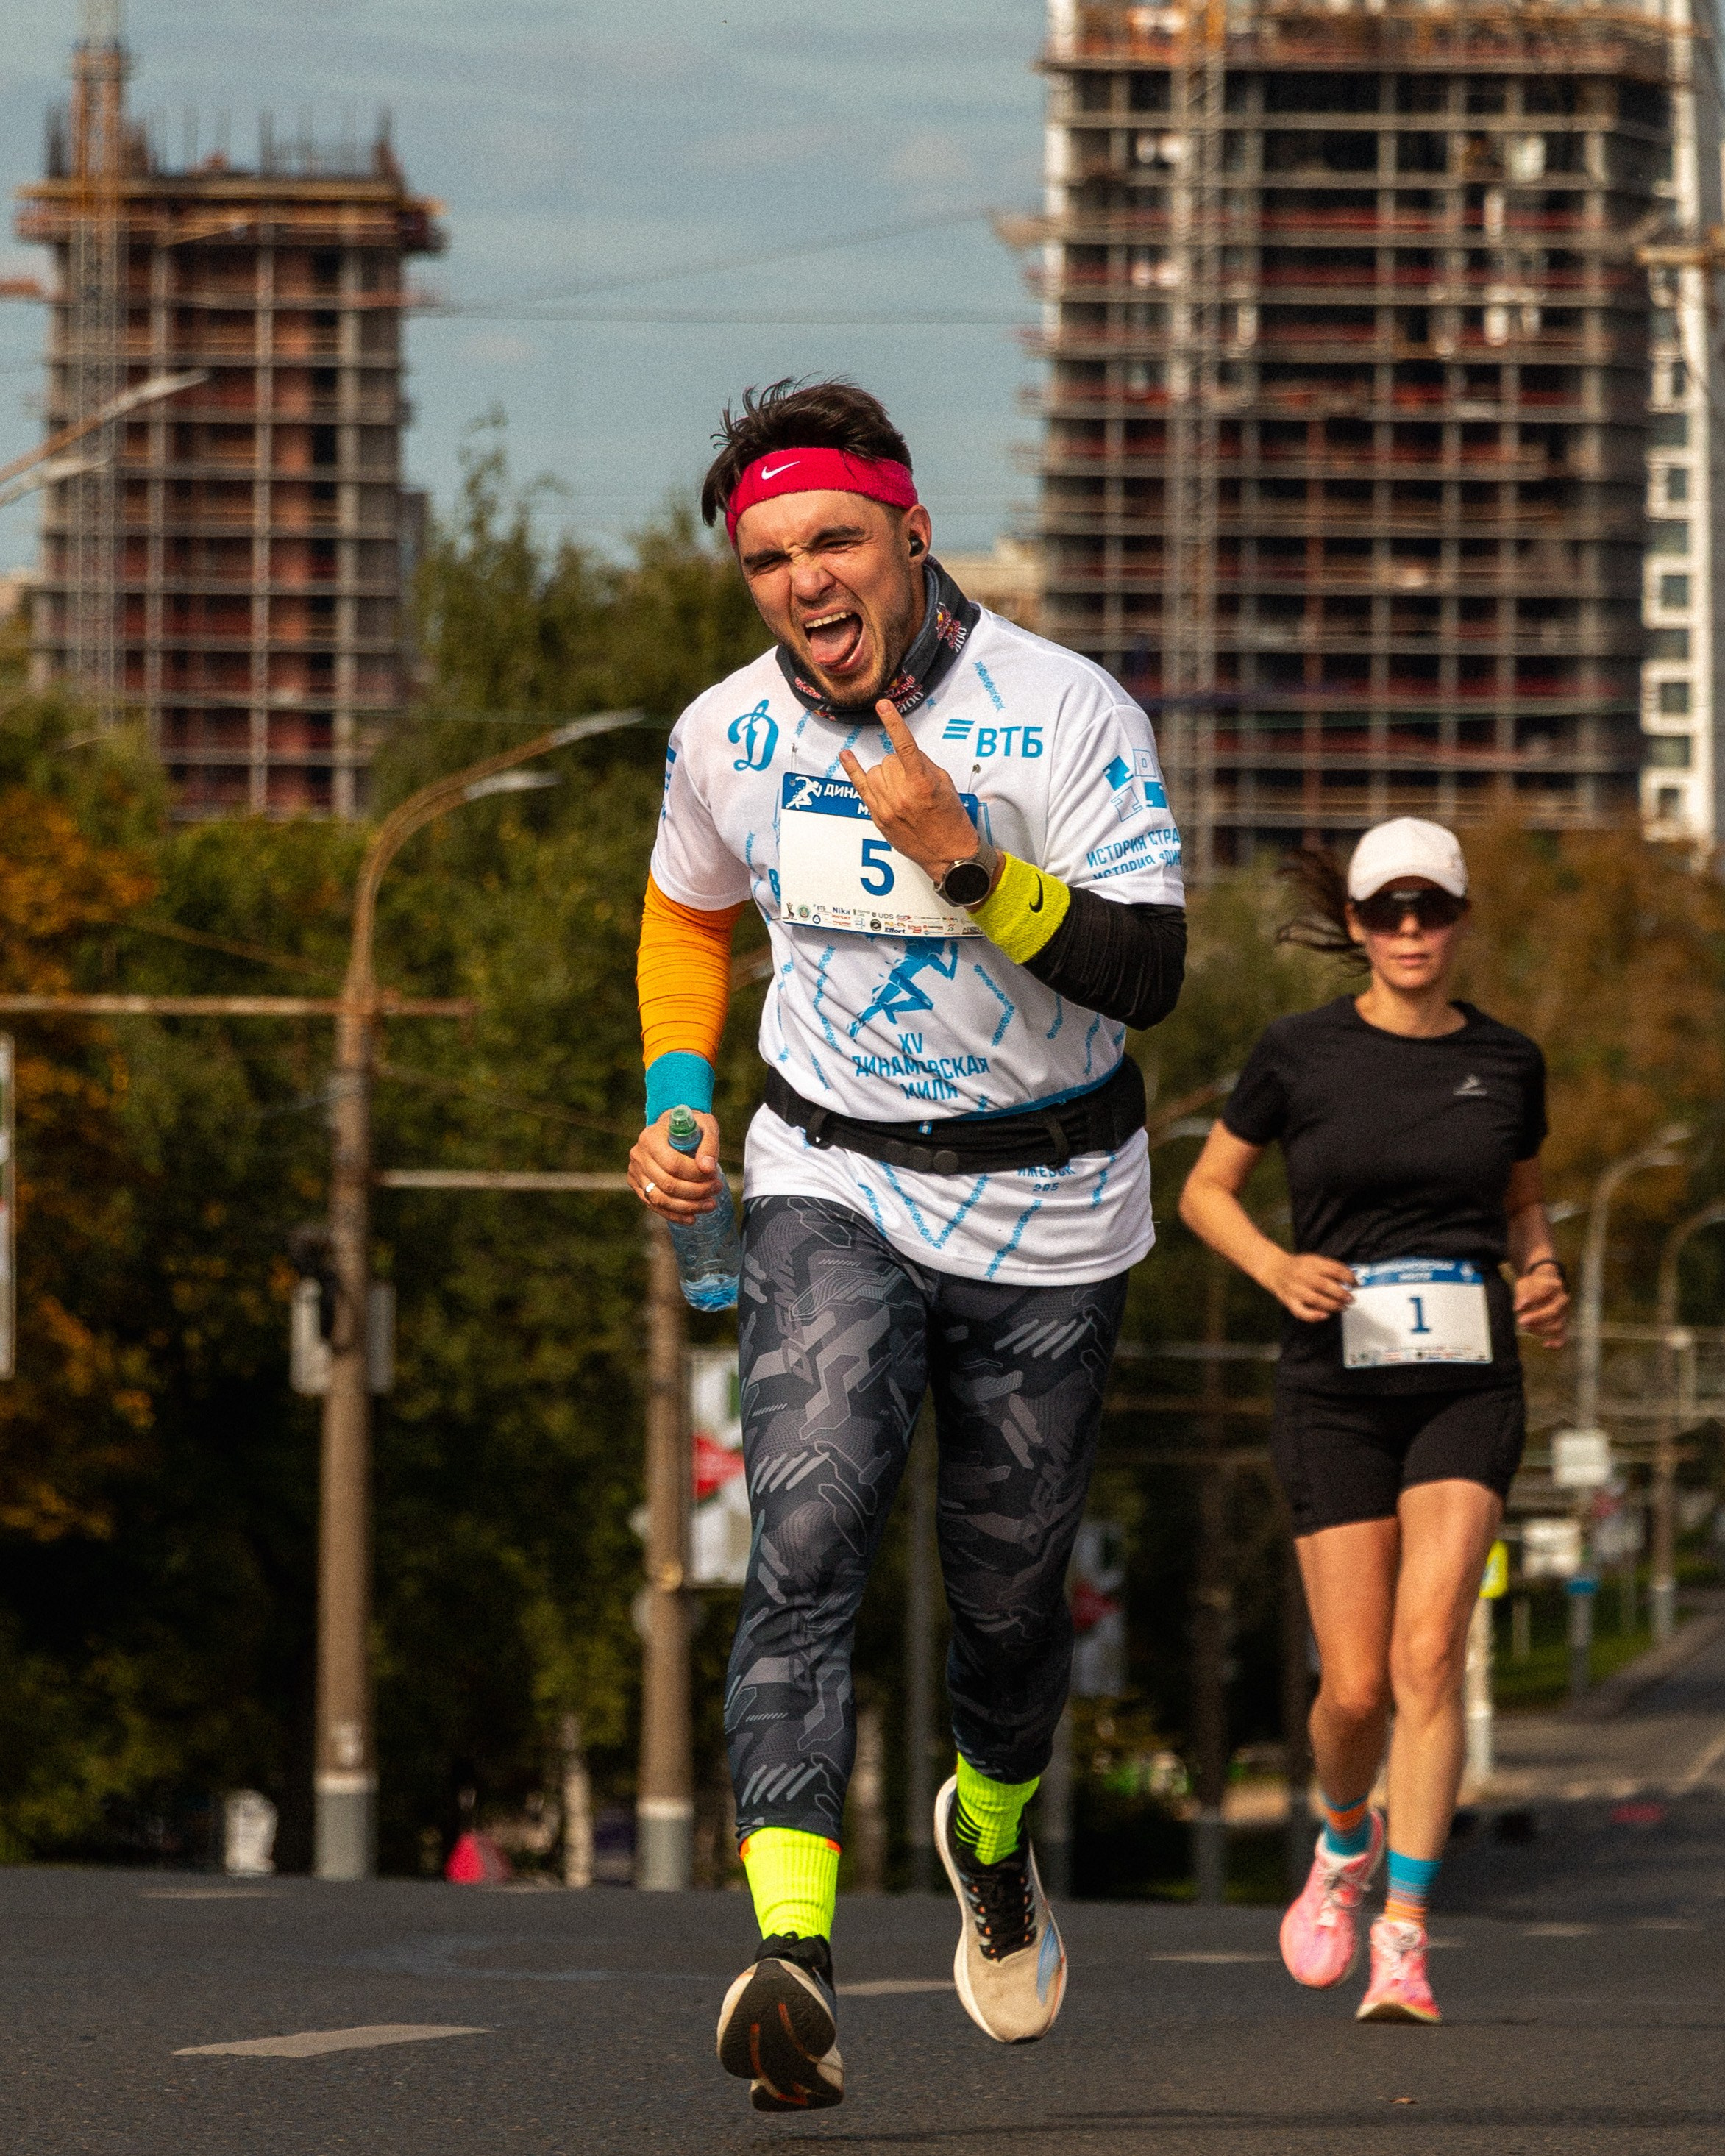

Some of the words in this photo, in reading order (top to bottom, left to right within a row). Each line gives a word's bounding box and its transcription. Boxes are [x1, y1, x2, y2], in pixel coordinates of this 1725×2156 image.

[975, 726, 1045, 759] ВТБ
[824, 784, 862, 800] ДИНА
[1086, 835, 1148, 868] ИСТОРИЯ
[1148, 828, 1181, 845] СТРА
[860, 838, 895, 897] 5
[832, 906, 851, 915] Nika
[898, 1032, 923, 1055] XV
[900, 1078, 958, 1100] МИЛЯ
[1409, 1297, 1431, 1334] 1
